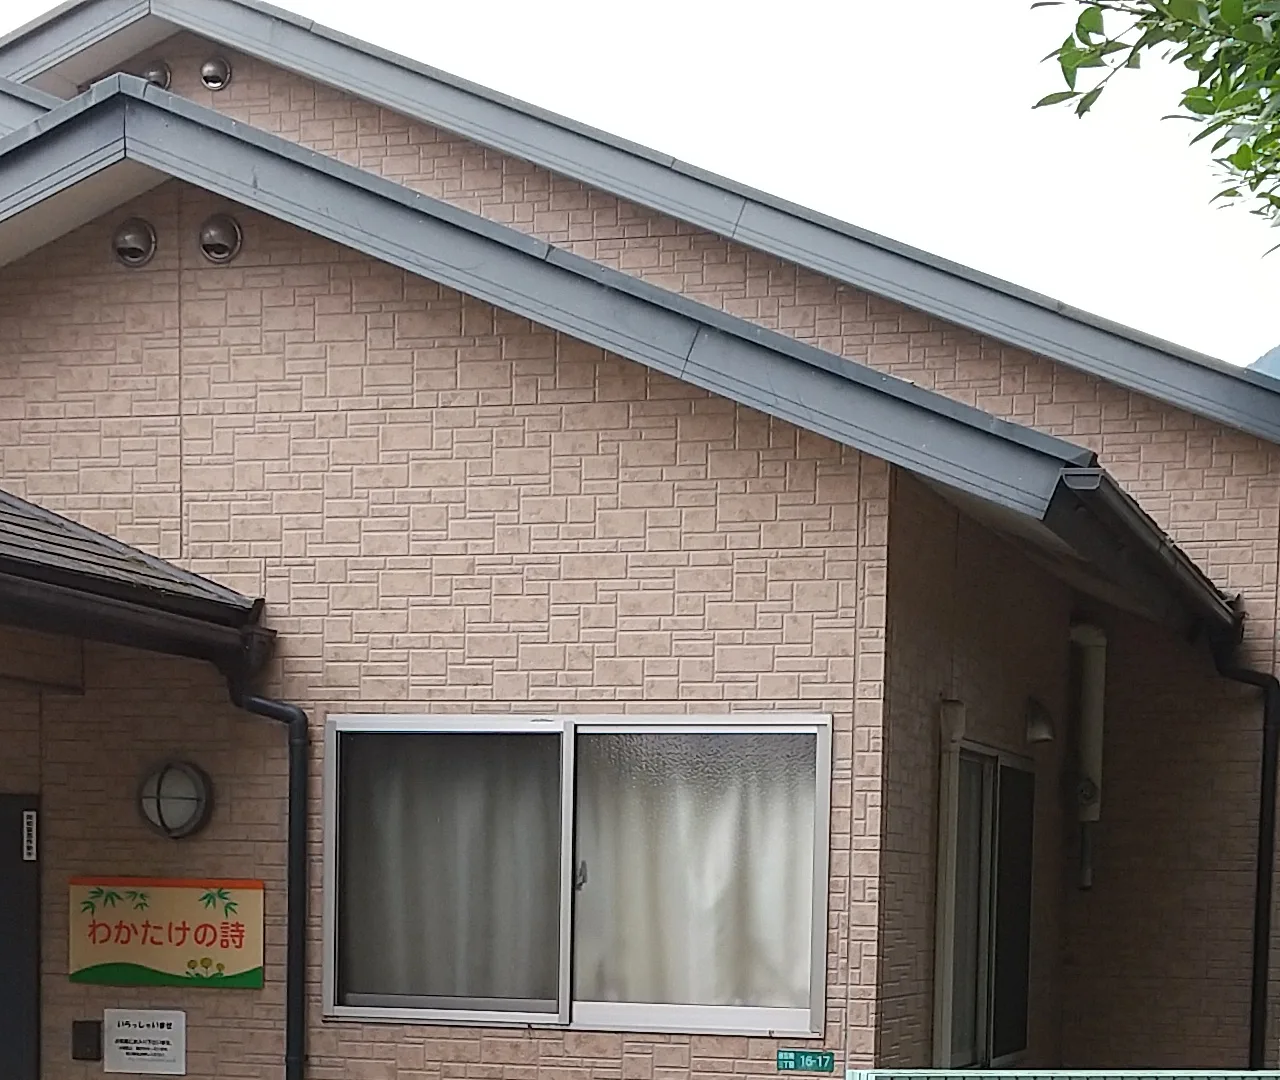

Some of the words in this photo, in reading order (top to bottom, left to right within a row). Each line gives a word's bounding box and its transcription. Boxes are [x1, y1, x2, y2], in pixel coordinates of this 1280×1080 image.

[88, 919, 245, 949] わかたけの詩
[800, 1055, 831, 1068] 16-17
